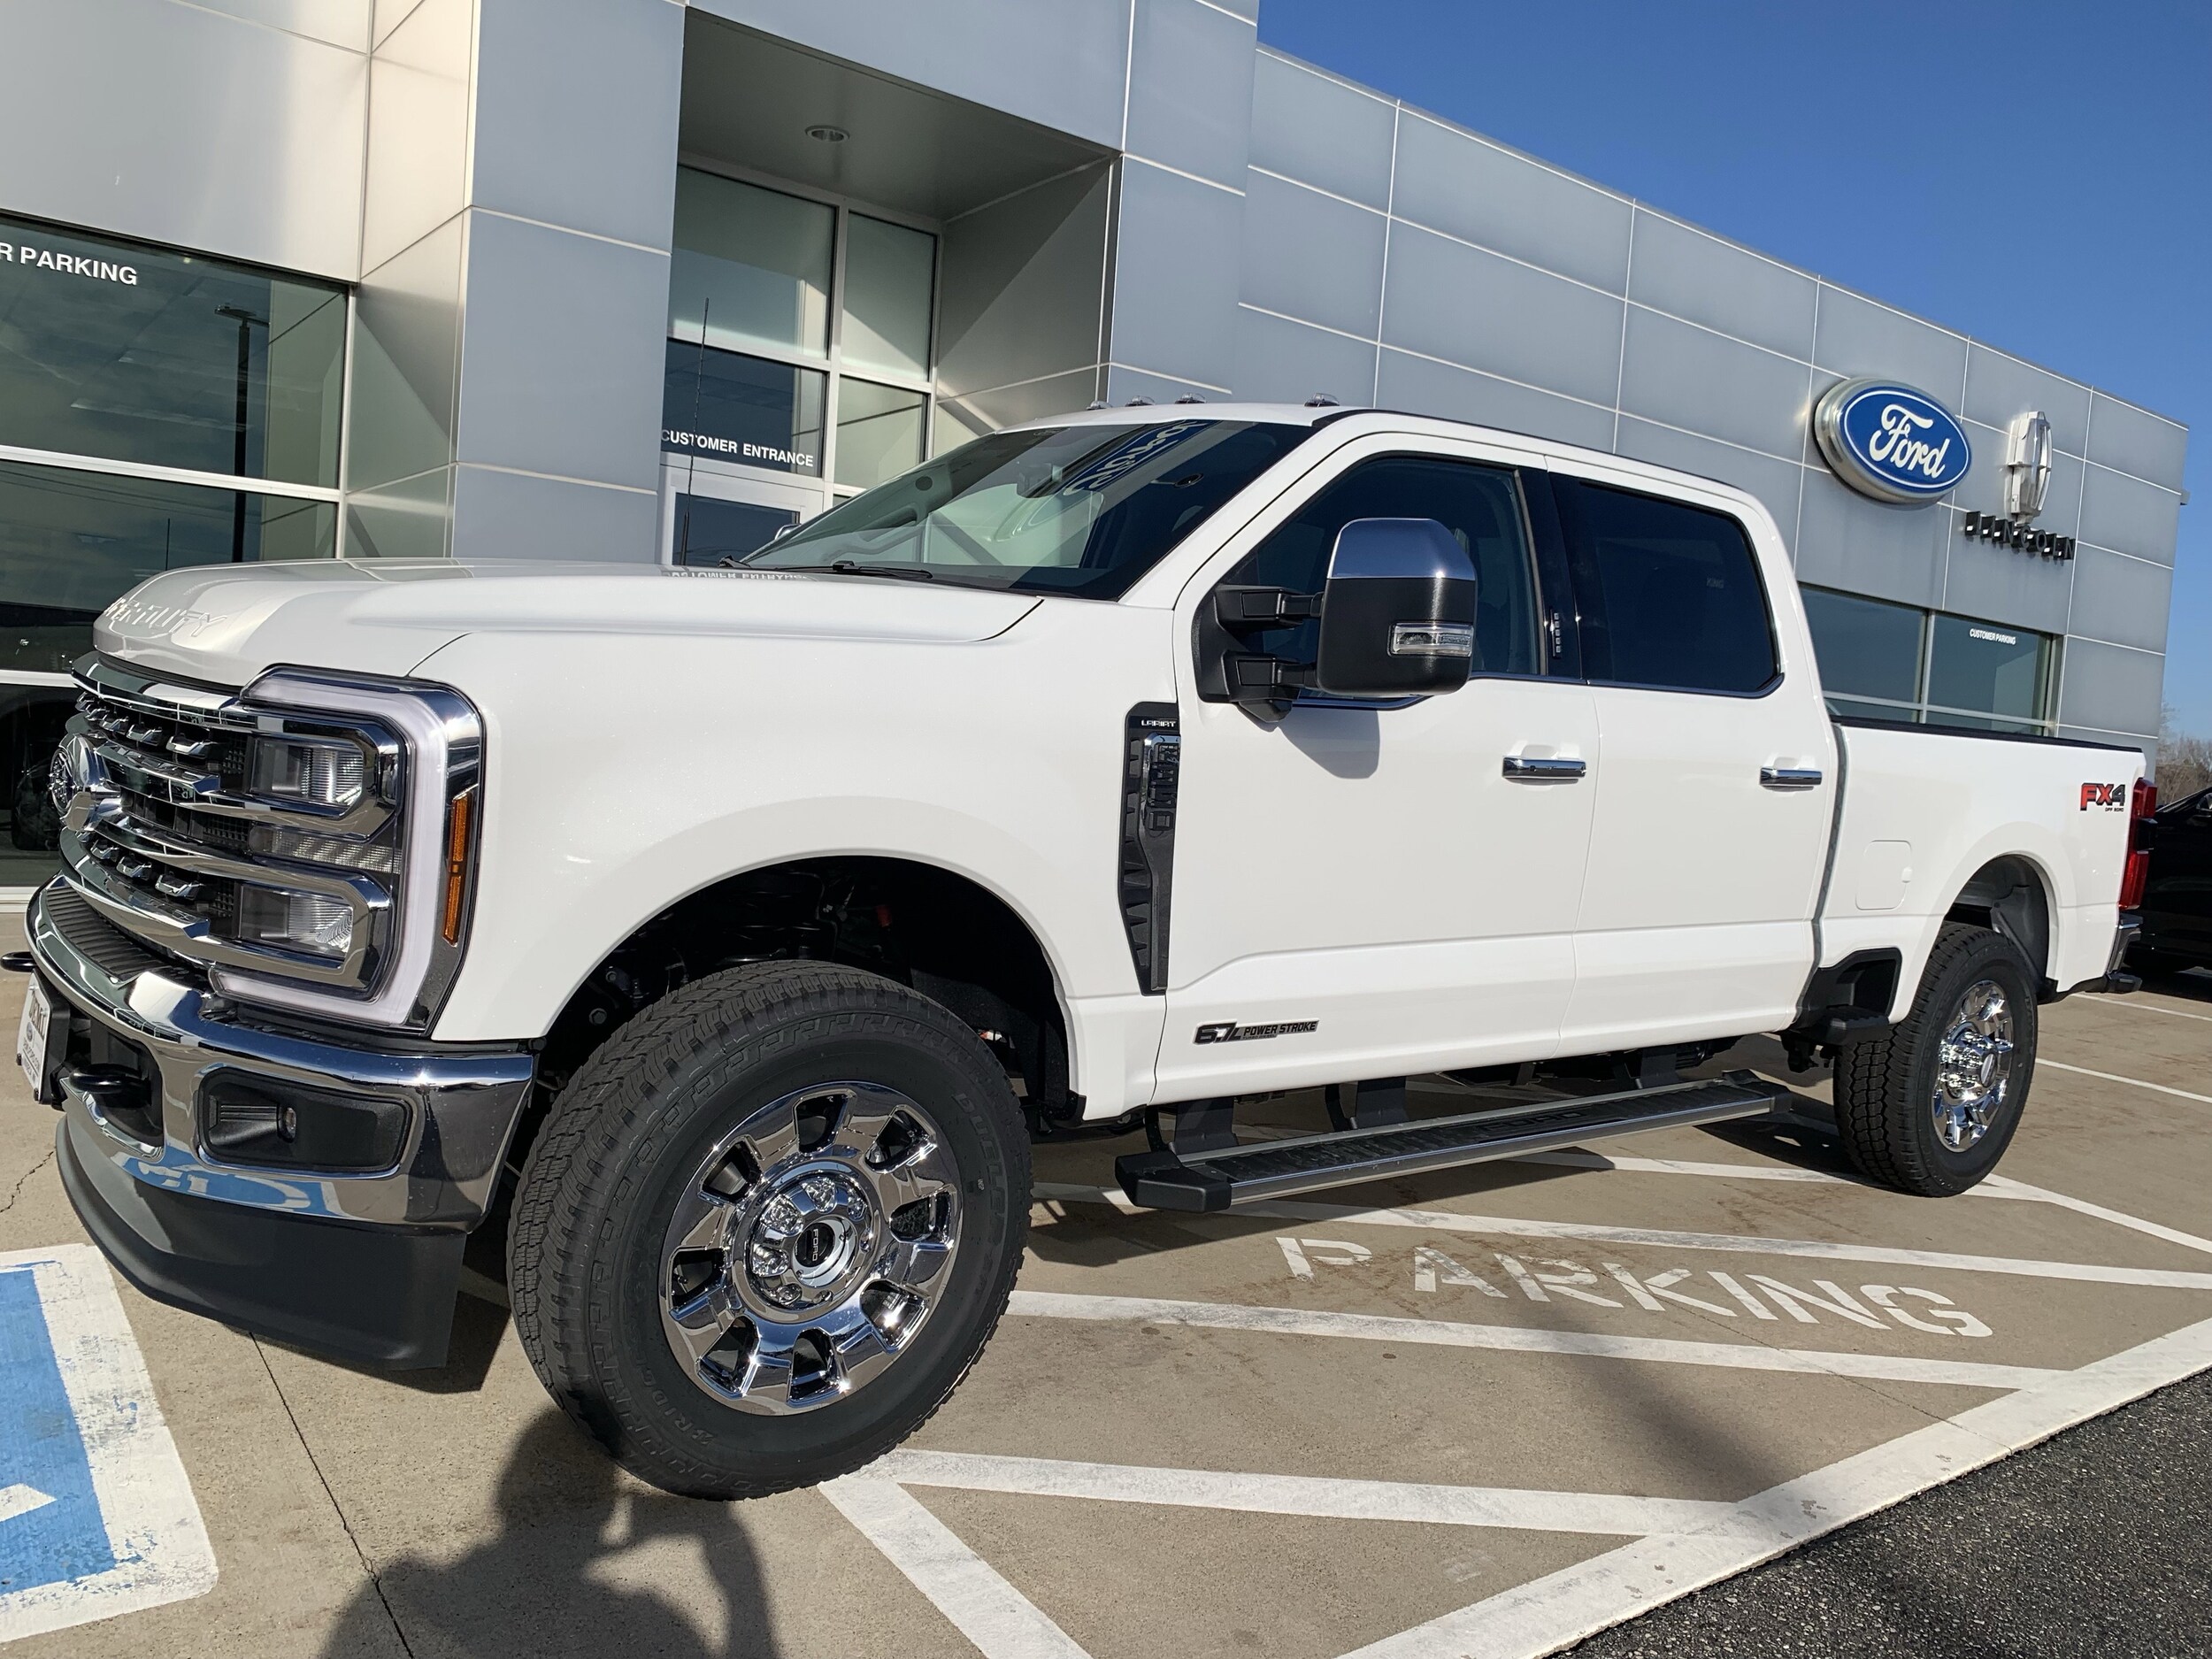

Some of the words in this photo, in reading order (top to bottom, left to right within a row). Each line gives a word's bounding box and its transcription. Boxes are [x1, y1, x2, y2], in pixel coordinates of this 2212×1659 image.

[19, 246, 137, 286] PARKING
[662, 429, 738, 454] CUSTOMER
[742, 443, 814, 467] ENTRANCE
[1869, 403, 1950, 479] Ford
[1970, 628, 1995, 641] CUSTOMER
[1995, 634, 2016, 645] PARKING
[2080, 782, 2126, 811] FX4
[1243, 1025, 1278, 1036] POWER
[1279, 1021, 1317, 1033] STROKE
[1276, 1236, 1993, 1338] PARKING
